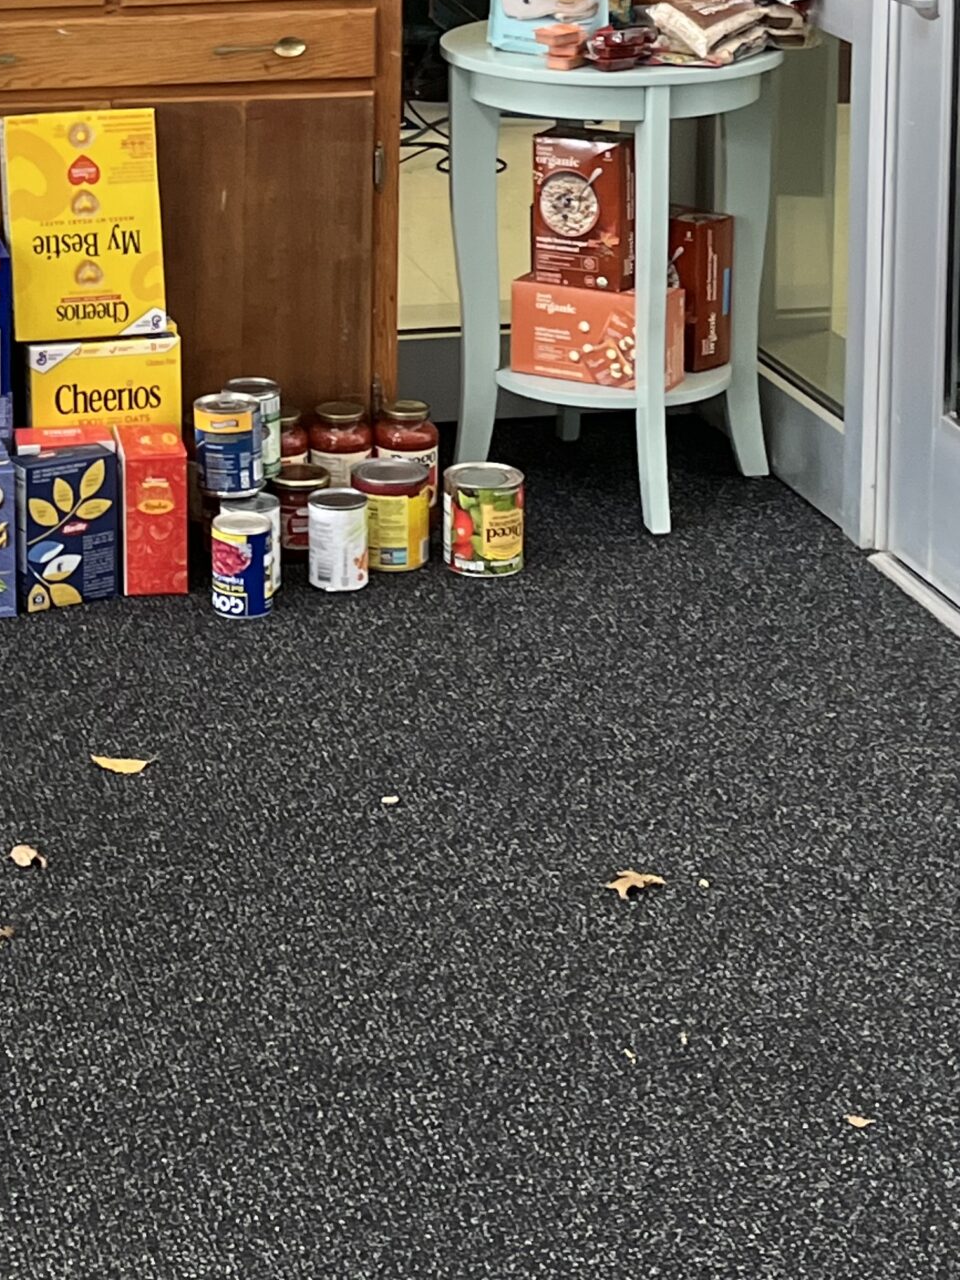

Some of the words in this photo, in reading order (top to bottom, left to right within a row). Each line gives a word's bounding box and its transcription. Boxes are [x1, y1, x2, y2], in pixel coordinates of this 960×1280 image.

[536, 155, 580, 169] organic
[32, 232, 100, 260] Bestie
[107, 224, 142, 255] My
[56, 300, 130, 323] Cheerios
[535, 302, 577, 315] organic
[55, 383, 162, 415] Cheerios
[124, 414, 151, 424] OATS
[486, 523, 522, 543] Diced
